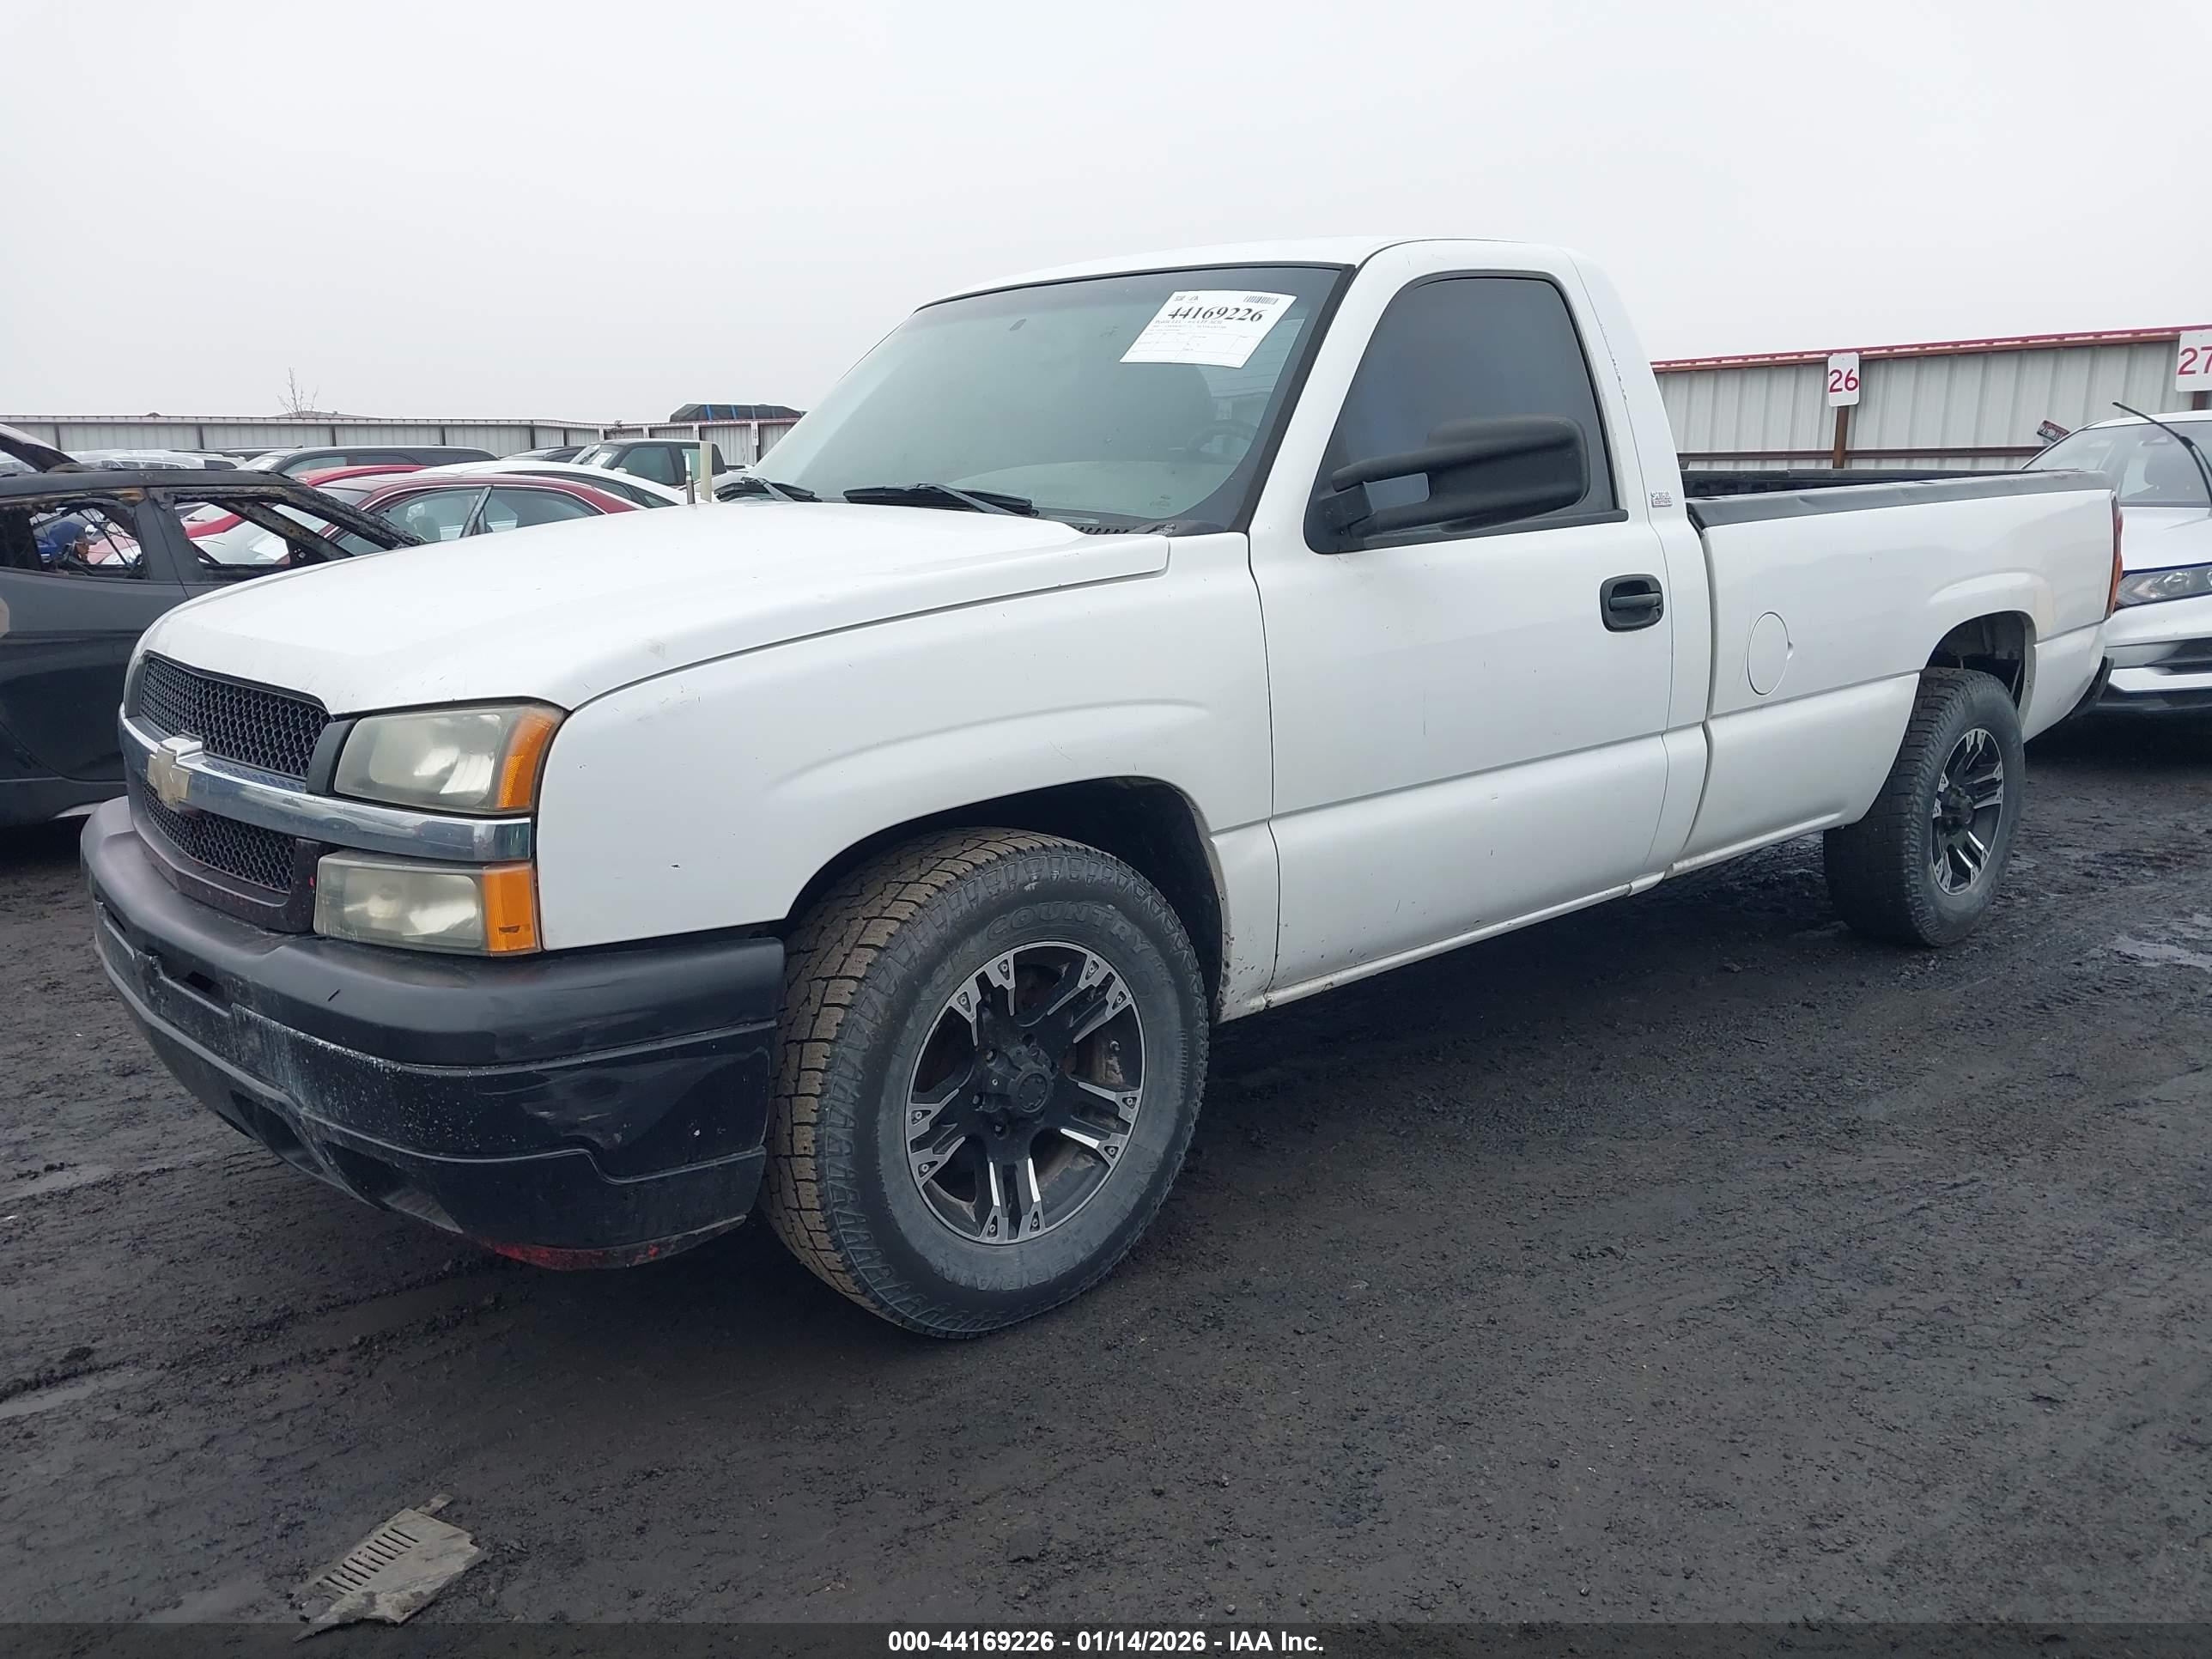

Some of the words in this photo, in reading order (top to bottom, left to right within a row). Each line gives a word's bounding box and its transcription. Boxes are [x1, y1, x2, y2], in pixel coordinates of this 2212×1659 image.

[1167, 307, 1267, 322] 44169226
[2178, 345, 2212, 375] 27
[1828, 368, 1860, 393] 26
[986, 900, 1151, 957] COUNTRY
